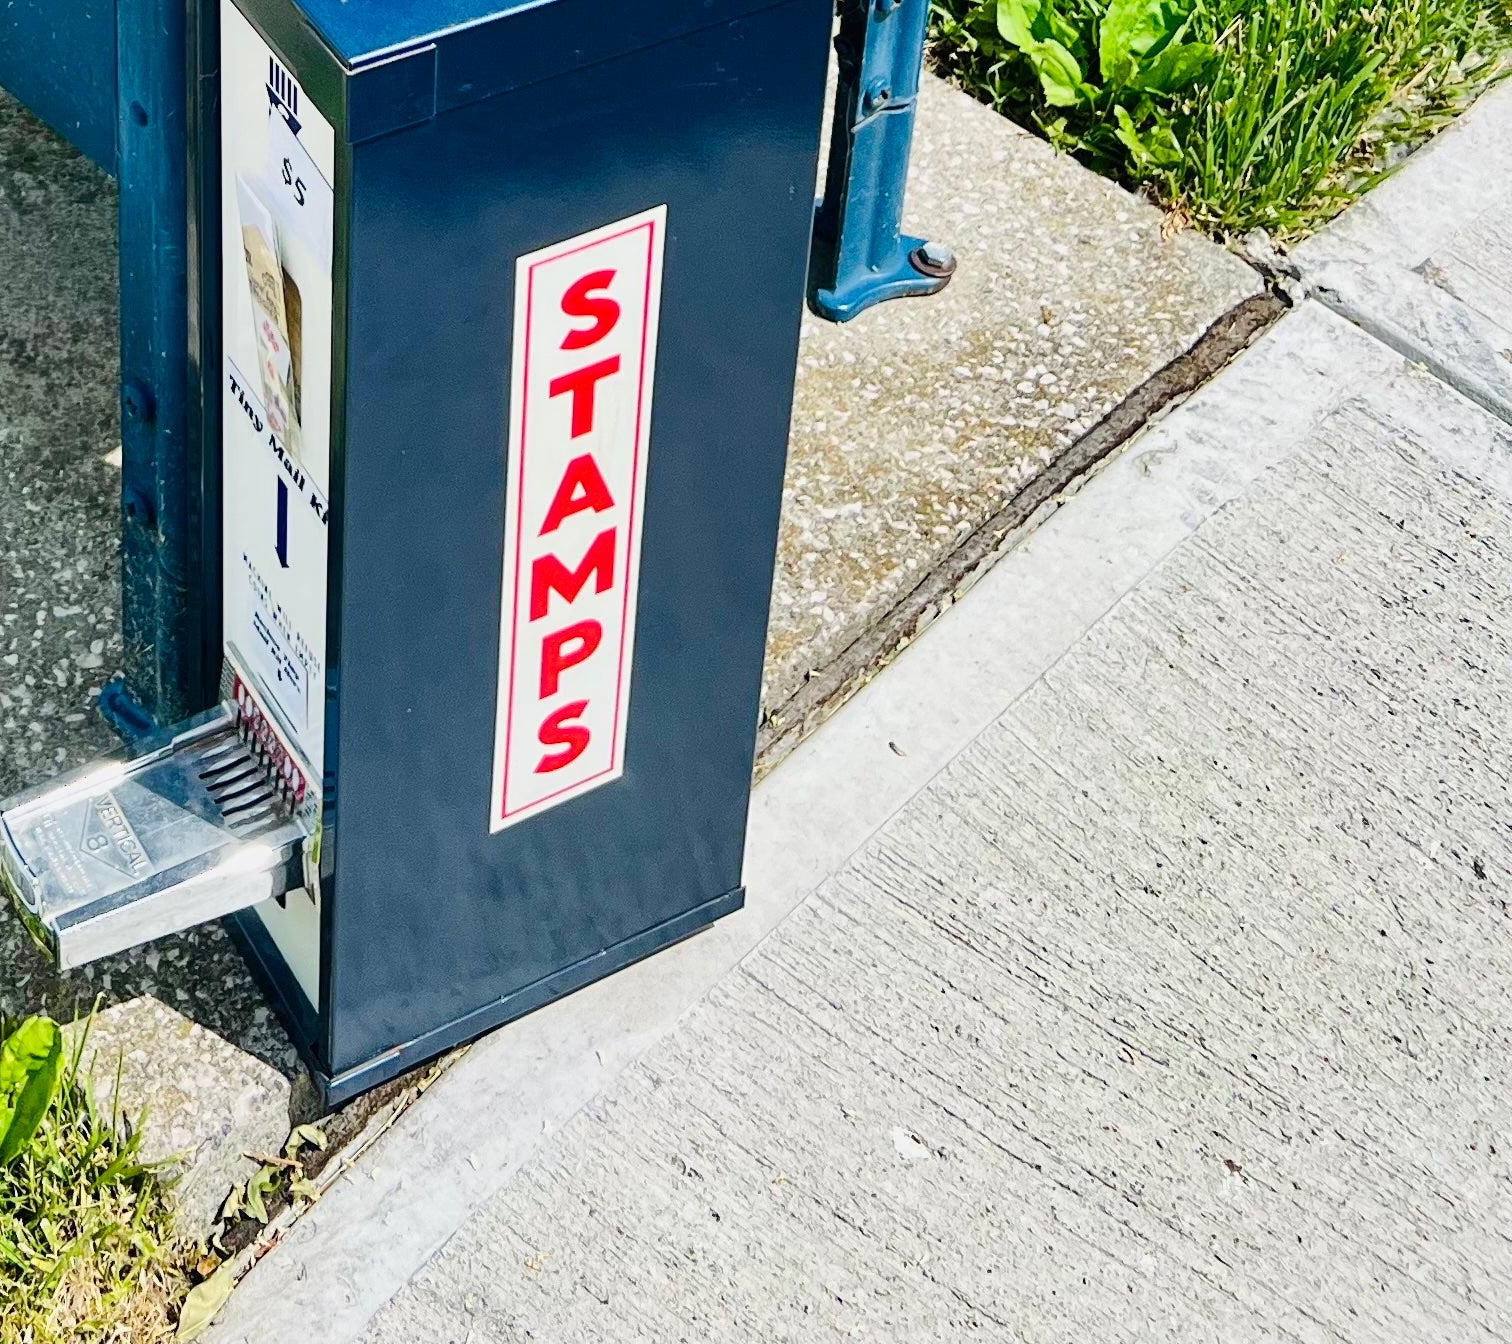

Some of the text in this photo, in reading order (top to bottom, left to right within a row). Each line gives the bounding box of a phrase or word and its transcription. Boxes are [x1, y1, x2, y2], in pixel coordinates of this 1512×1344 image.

[282, 158, 307, 206] $5
[229, 374, 264, 432] Tiny
[268, 434, 306, 492] Mail
[529, 268, 621, 774] STAMPS
[87, 834, 109, 853] 8
[95, 794, 148, 876] VERTICAL
